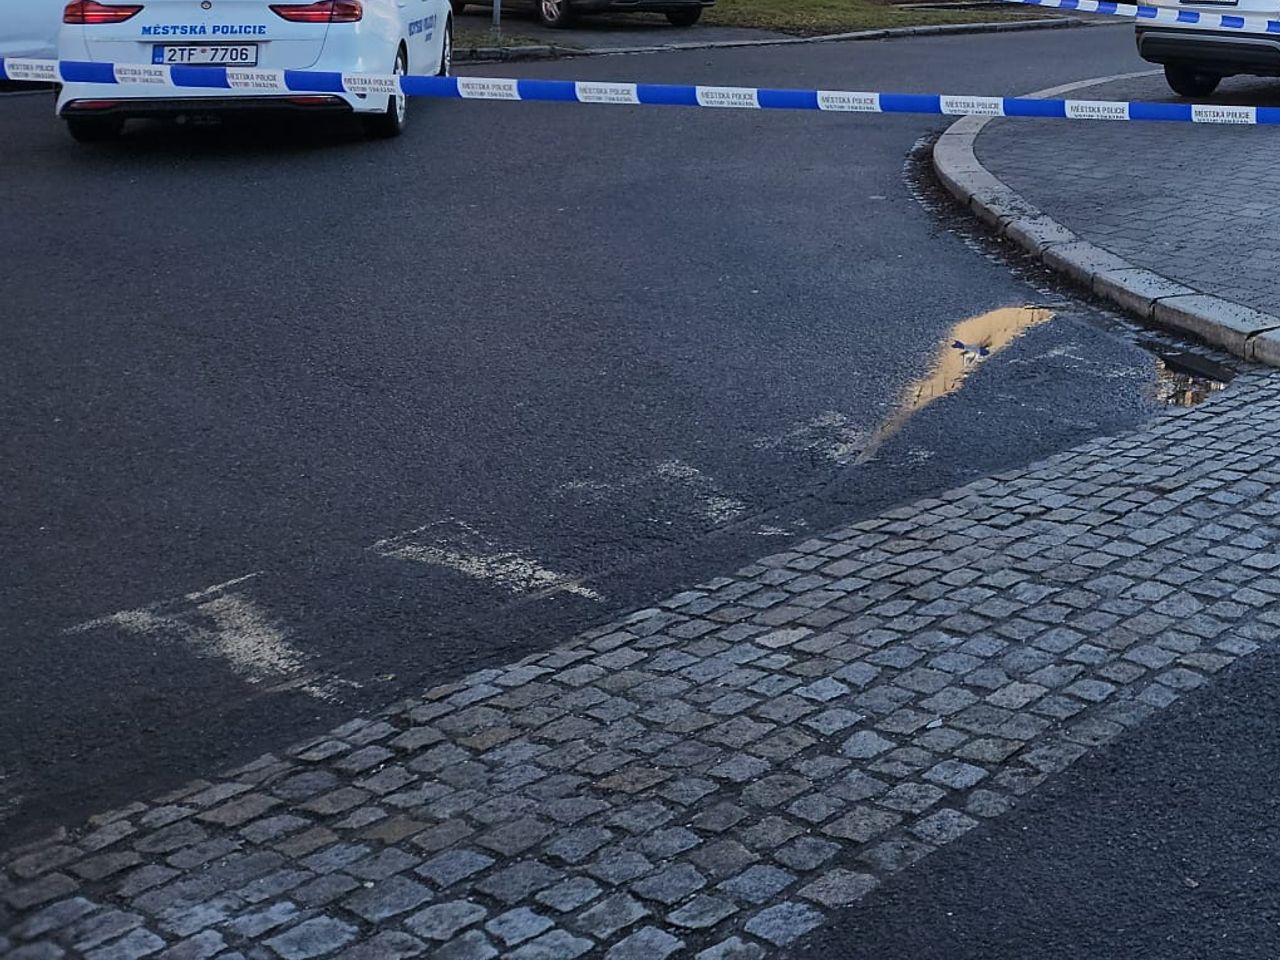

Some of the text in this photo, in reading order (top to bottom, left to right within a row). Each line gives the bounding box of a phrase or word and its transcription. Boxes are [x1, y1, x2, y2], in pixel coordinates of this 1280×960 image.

[142, 22, 267, 35] MĚSTSKÁ POLICIE
[168, 48, 197, 62] 2TF
[210, 48, 249, 62] 7706
